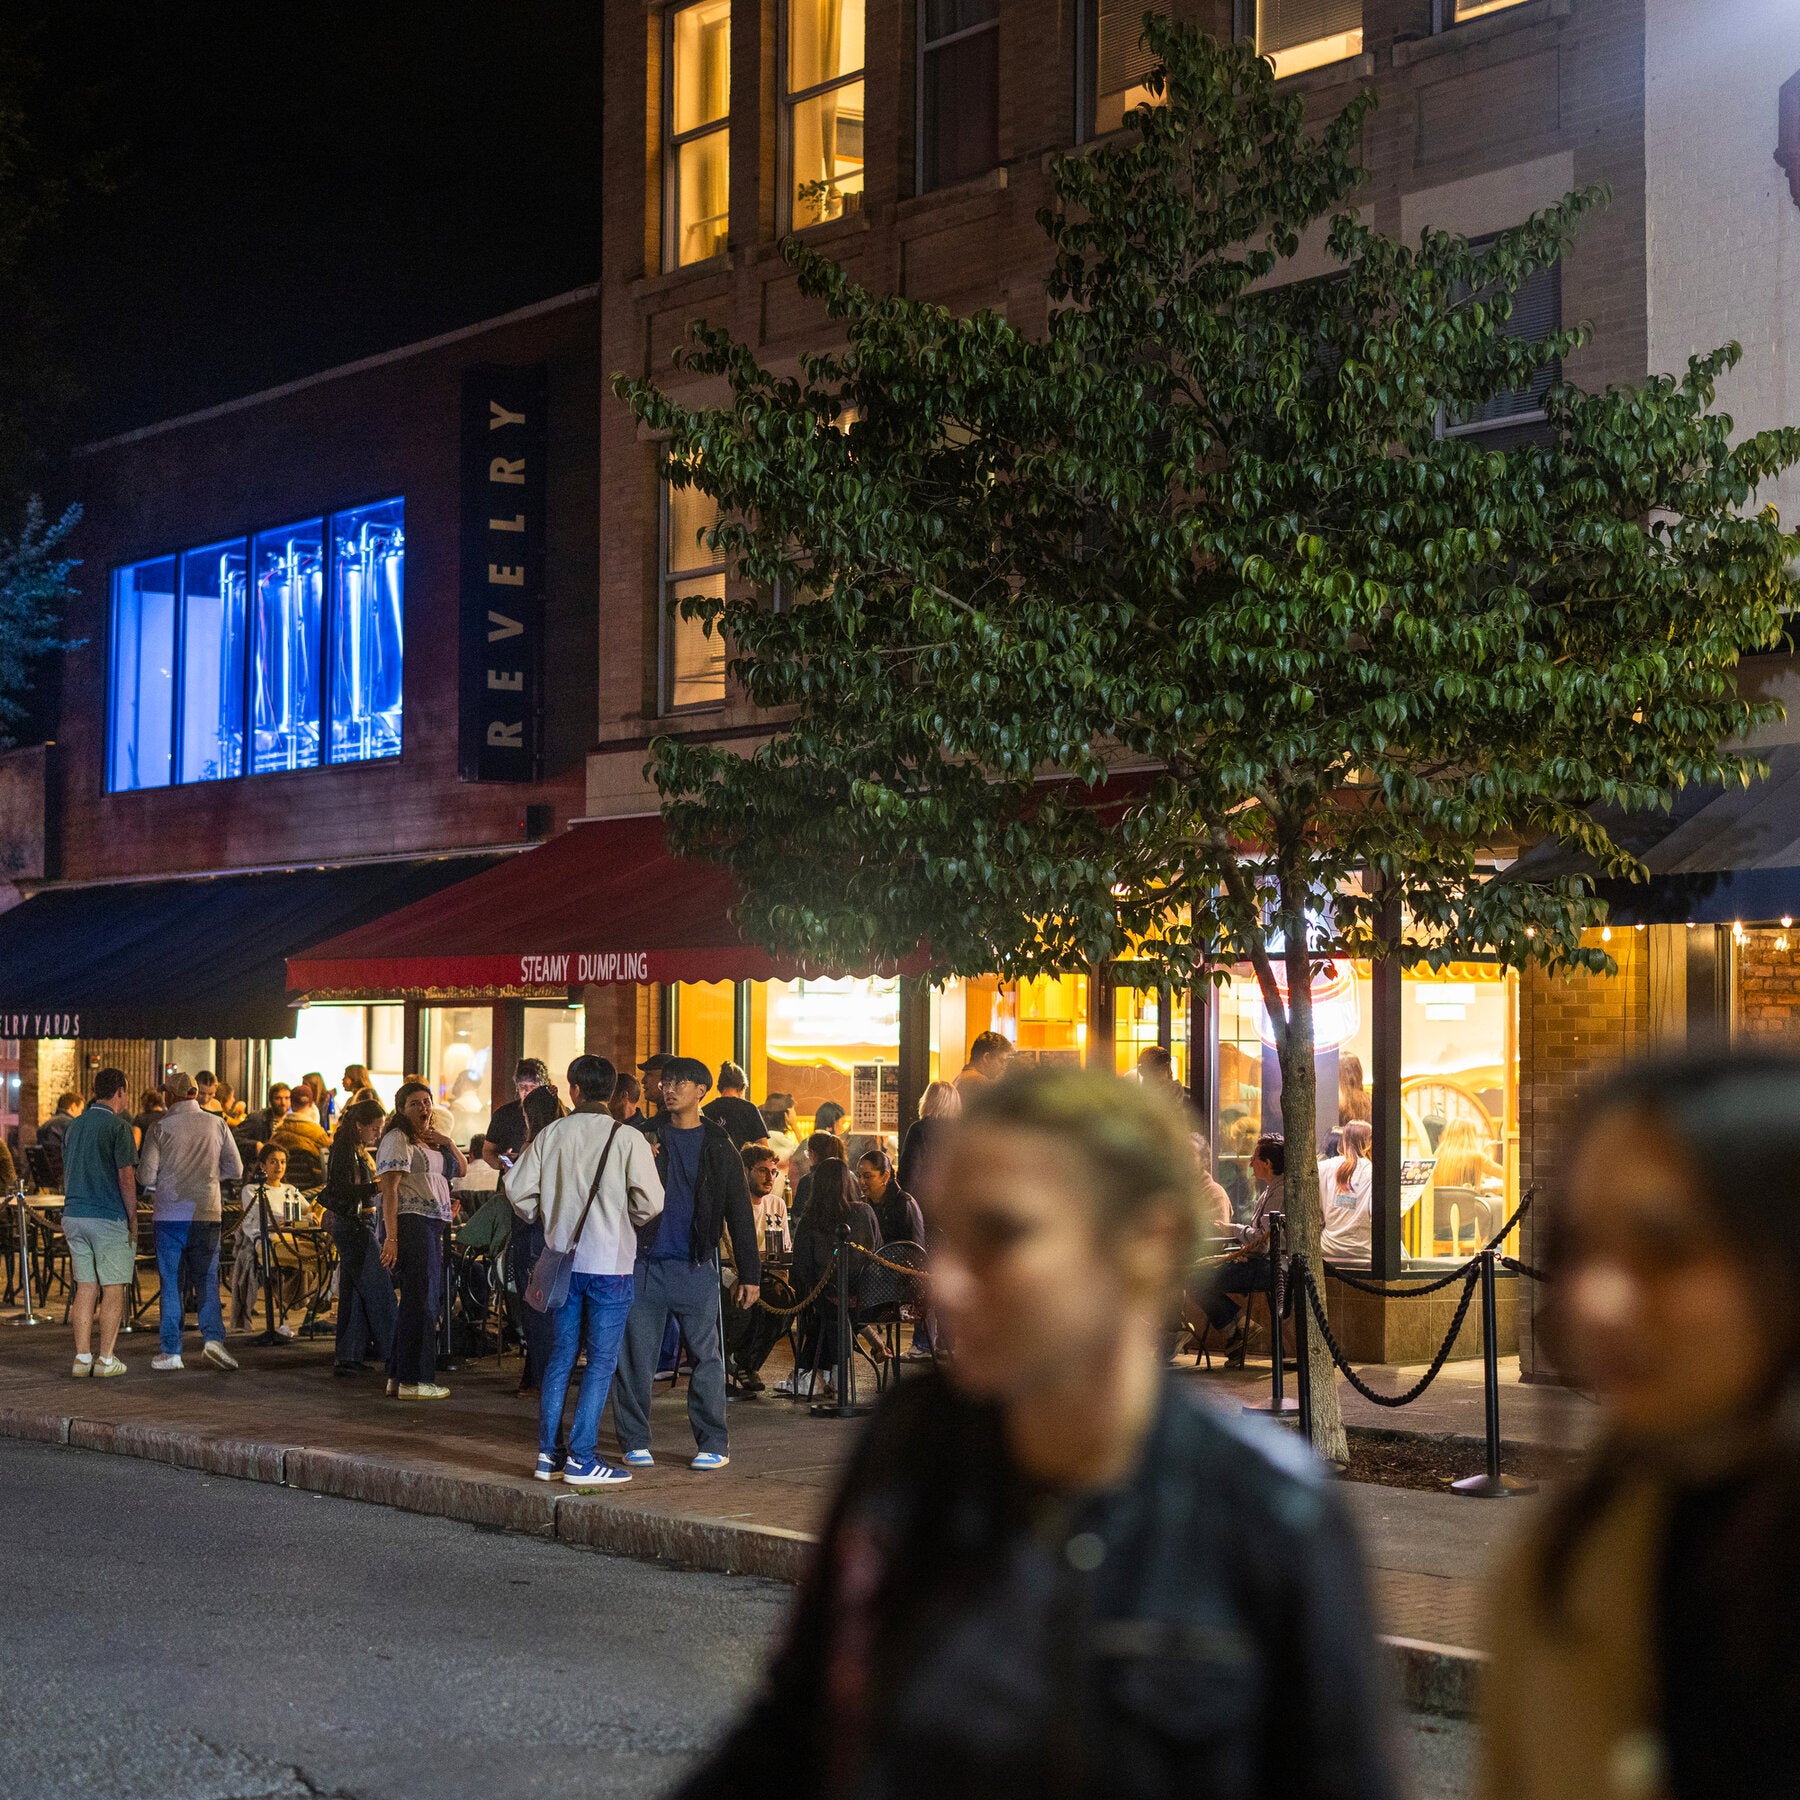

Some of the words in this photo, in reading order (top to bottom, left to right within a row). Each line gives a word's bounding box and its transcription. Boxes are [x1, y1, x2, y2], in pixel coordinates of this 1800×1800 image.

[487, 400, 526, 747] REVELRY
[521, 955, 570, 982] STEAMY
[578, 952, 648, 981] DUMPLING
[35, 1014, 80, 1035] YARDS
